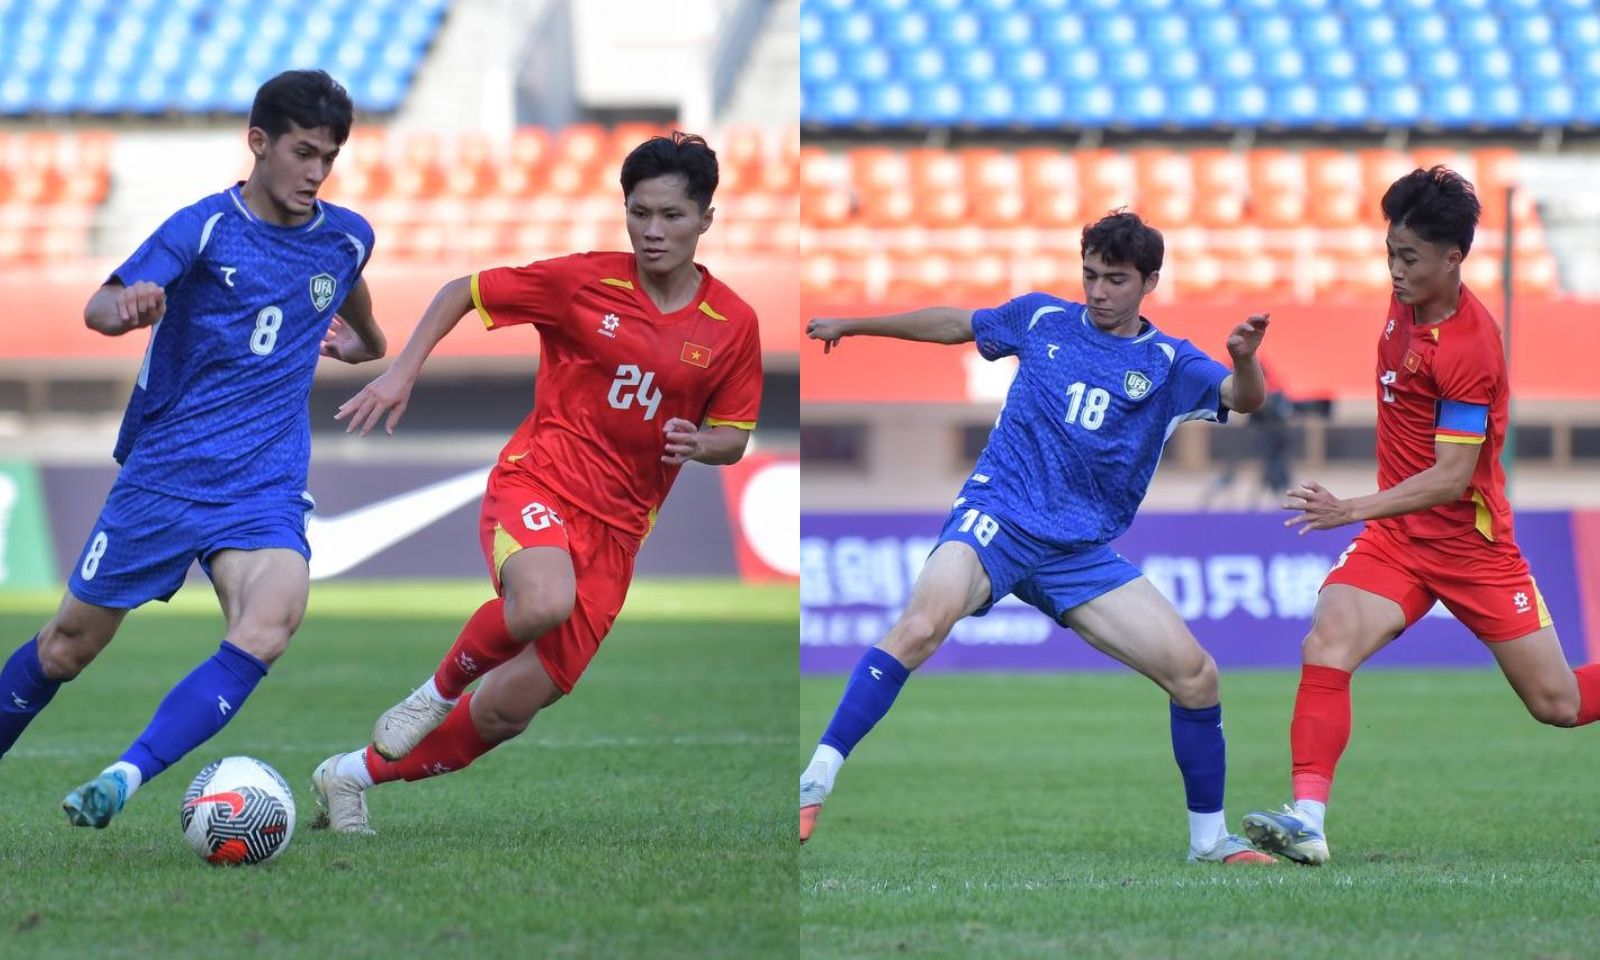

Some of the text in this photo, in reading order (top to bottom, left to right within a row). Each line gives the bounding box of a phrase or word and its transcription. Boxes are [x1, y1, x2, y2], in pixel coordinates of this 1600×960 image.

[313, 278, 333, 295] UFA
[249, 305, 284, 356] 8
[607, 364, 663, 421] 24
[1064, 382, 1111, 431] 18
[1127, 373, 1148, 391] UFA
[957, 508, 999, 548] 18
[81, 530, 109, 581] 8
